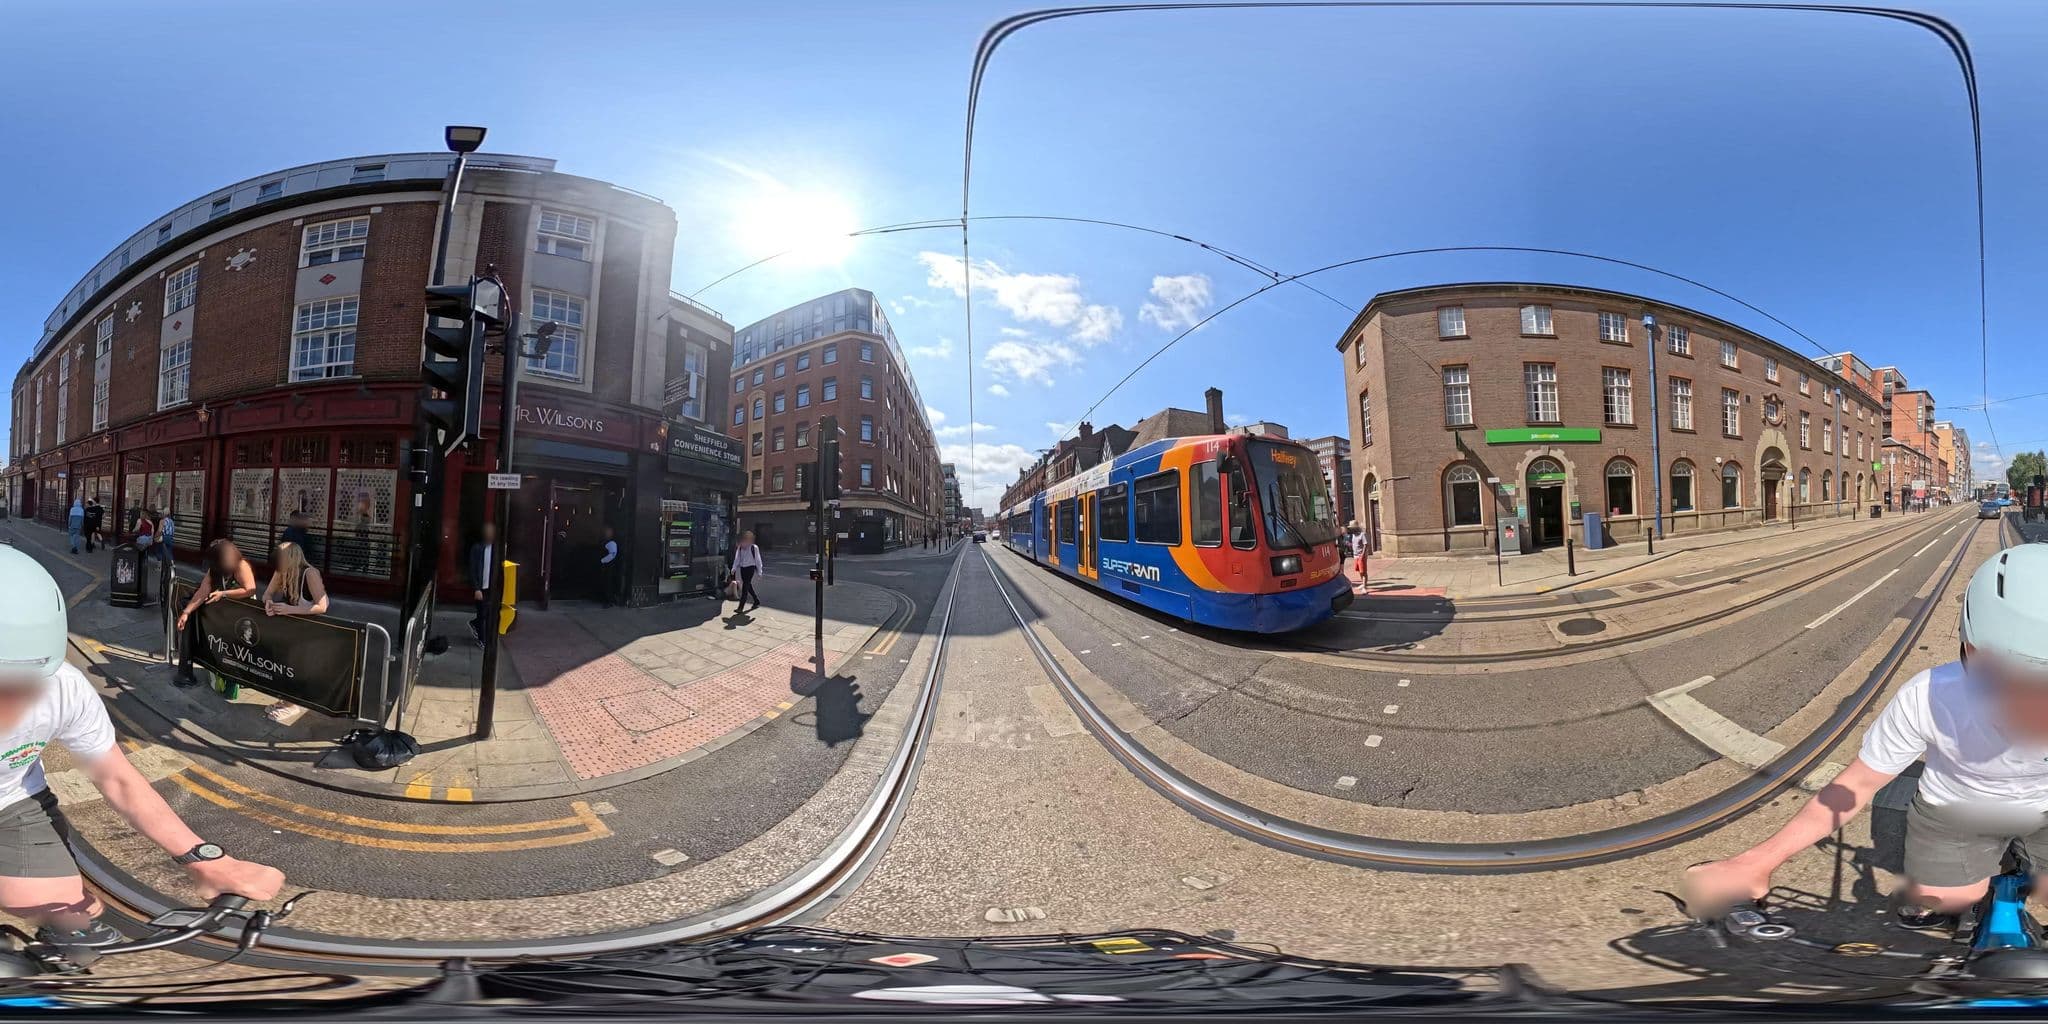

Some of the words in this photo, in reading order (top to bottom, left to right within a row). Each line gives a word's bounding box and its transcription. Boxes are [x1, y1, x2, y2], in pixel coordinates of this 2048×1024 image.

[674, 438, 722, 458] CONVENIENCE
[723, 451, 741, 463] STORE
[694, 433, 728, 449] SHEFFIELD
[1206, 440, 1220, 453] 114
[1321, 545, 1331, 558] 114
[1102, 557, 1160, 582] SUPERTRAM
[232, 643, 295, 679] WILSON'S
